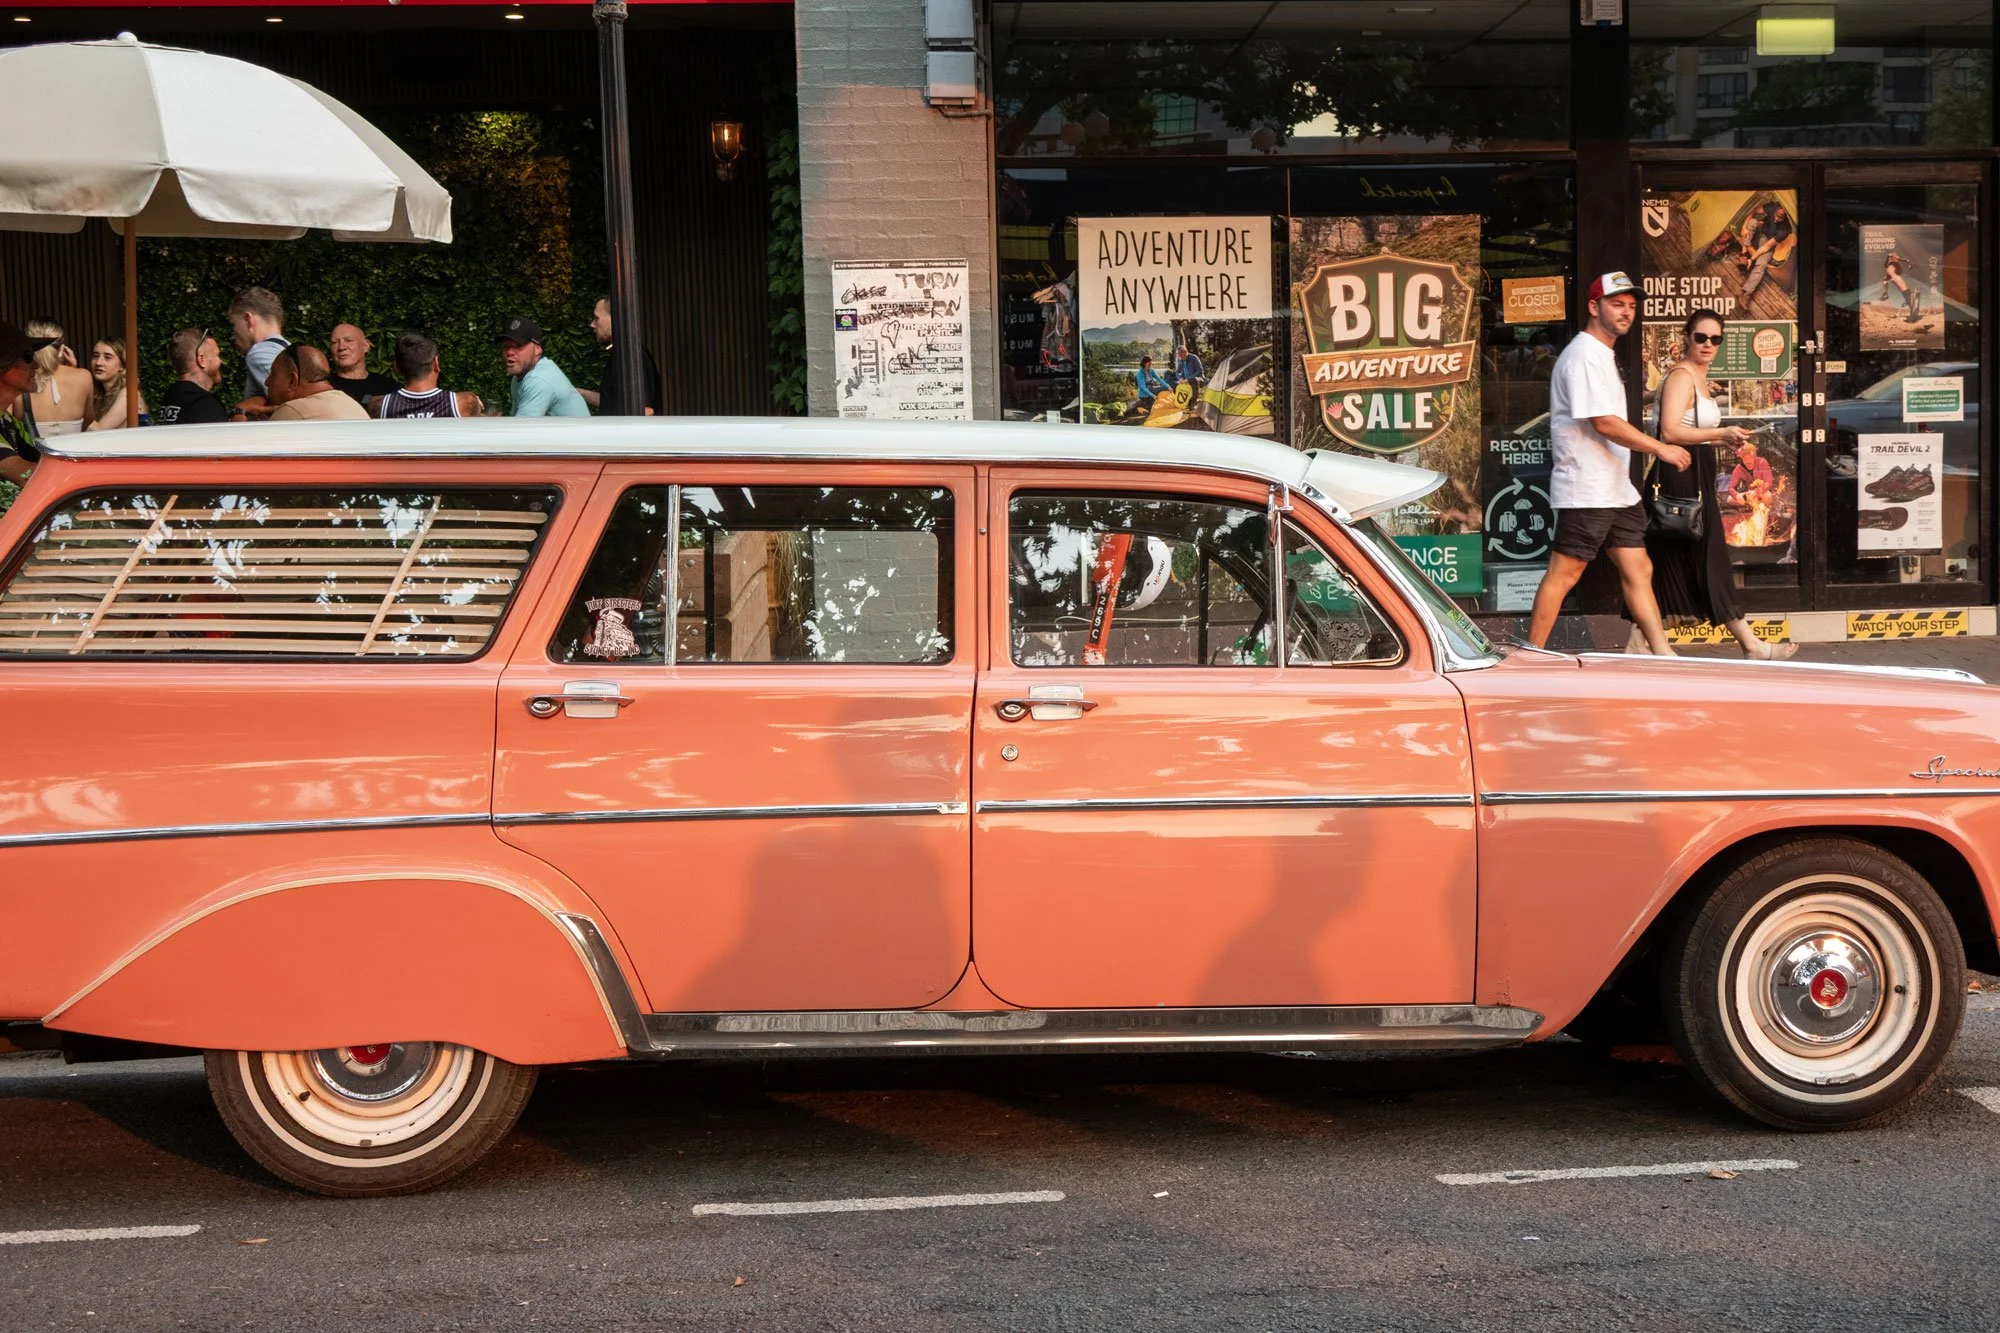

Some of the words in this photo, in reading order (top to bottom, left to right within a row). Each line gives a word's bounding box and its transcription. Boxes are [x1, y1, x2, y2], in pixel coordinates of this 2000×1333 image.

[1099, 227, 1253, 269] ADVENTURE
[1105, 272, 1248, 315] ANYWHERE
[1644, 277, 1676, 296] ONE
[1680, 277, 1722, 296] STOP
[1327, 272, 1444, 344] BIG
[1508, 294, 1560, 307] CLOSED
[1644, 298, 1687, 317] GEAR
[1691, 298, 1736, 316] SHOP
[1314, 352, 1463, 382] ADVENTURE
[1343, 392, 1434, 430] SALE
[1502, 453, 1544, 464] HERE!
[1897, 445, 1923, 453] DEVIL
[1674, 626, 1715, 637] WATCH
[1753, 626, 1783, 636] STEP
[1852, 620, 1892, 632] WATCH
[1895, 620, 1928, 632] YOUR
[1930, 619, 1960, 630] STEP
